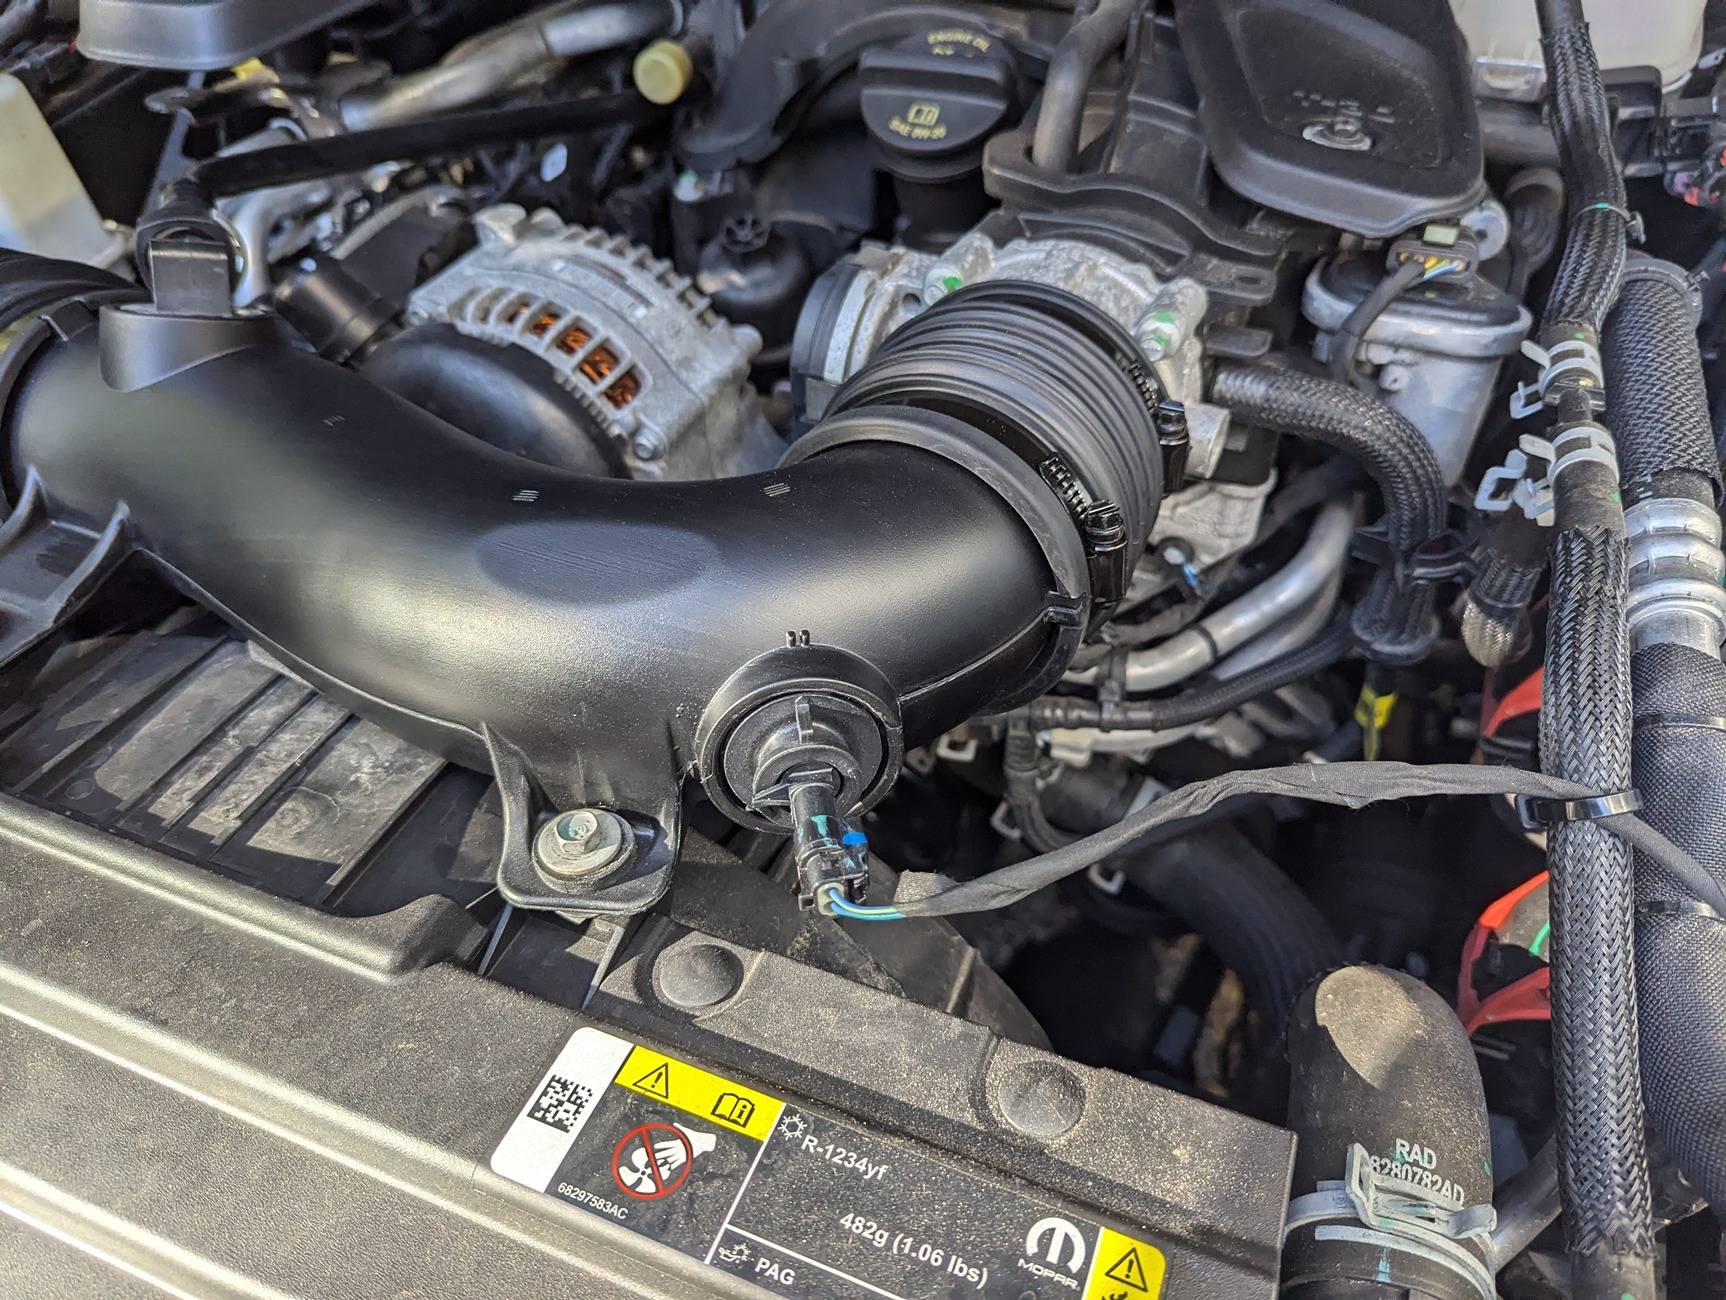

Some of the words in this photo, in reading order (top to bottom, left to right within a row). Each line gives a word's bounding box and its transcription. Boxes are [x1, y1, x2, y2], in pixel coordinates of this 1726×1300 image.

[801, 1134, 889, 1180] R-1234yf
[1395, 1138, 1437, 1170] RAD
[557, 1182, 629, 1219] 68297583AC
[839, 1212, 889, 1248] 482g
[892, 1233, 945, 1267] (1.06
[947, 1254, 988, 1290] lbs)
[754, 1257, 796, 1285] PAG
